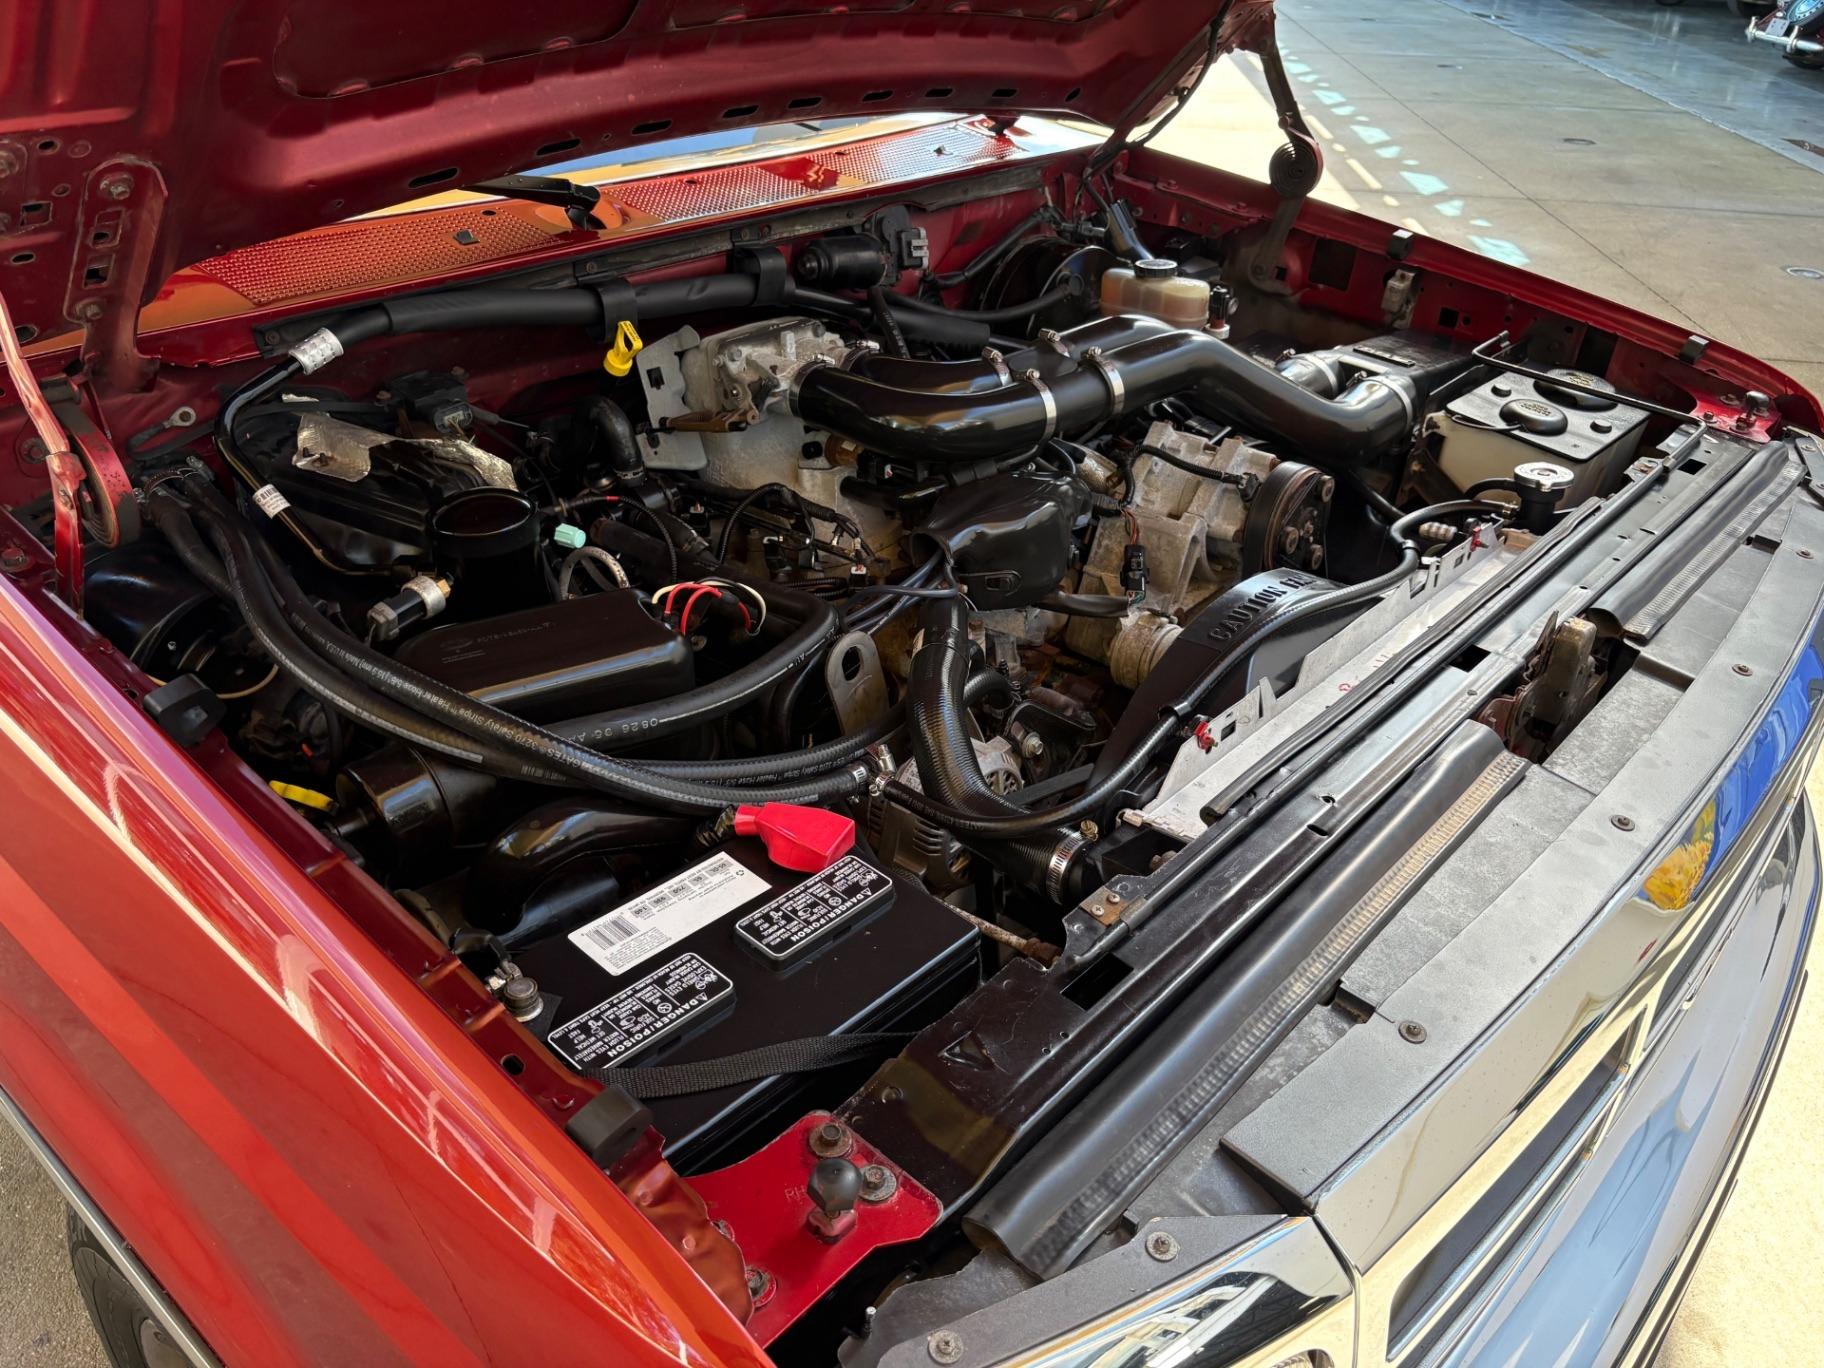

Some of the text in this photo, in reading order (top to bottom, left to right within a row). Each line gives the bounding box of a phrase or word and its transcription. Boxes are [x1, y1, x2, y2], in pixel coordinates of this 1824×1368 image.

[1207, 585, 1287, 639] CAUTION
[513, 734, 538, 750] 3270
[633, 906, 647, 914] 140
[789, 893, 864, 941] DANGER/POISON
[606, 998, 698, 1057] DANGER/POISON
